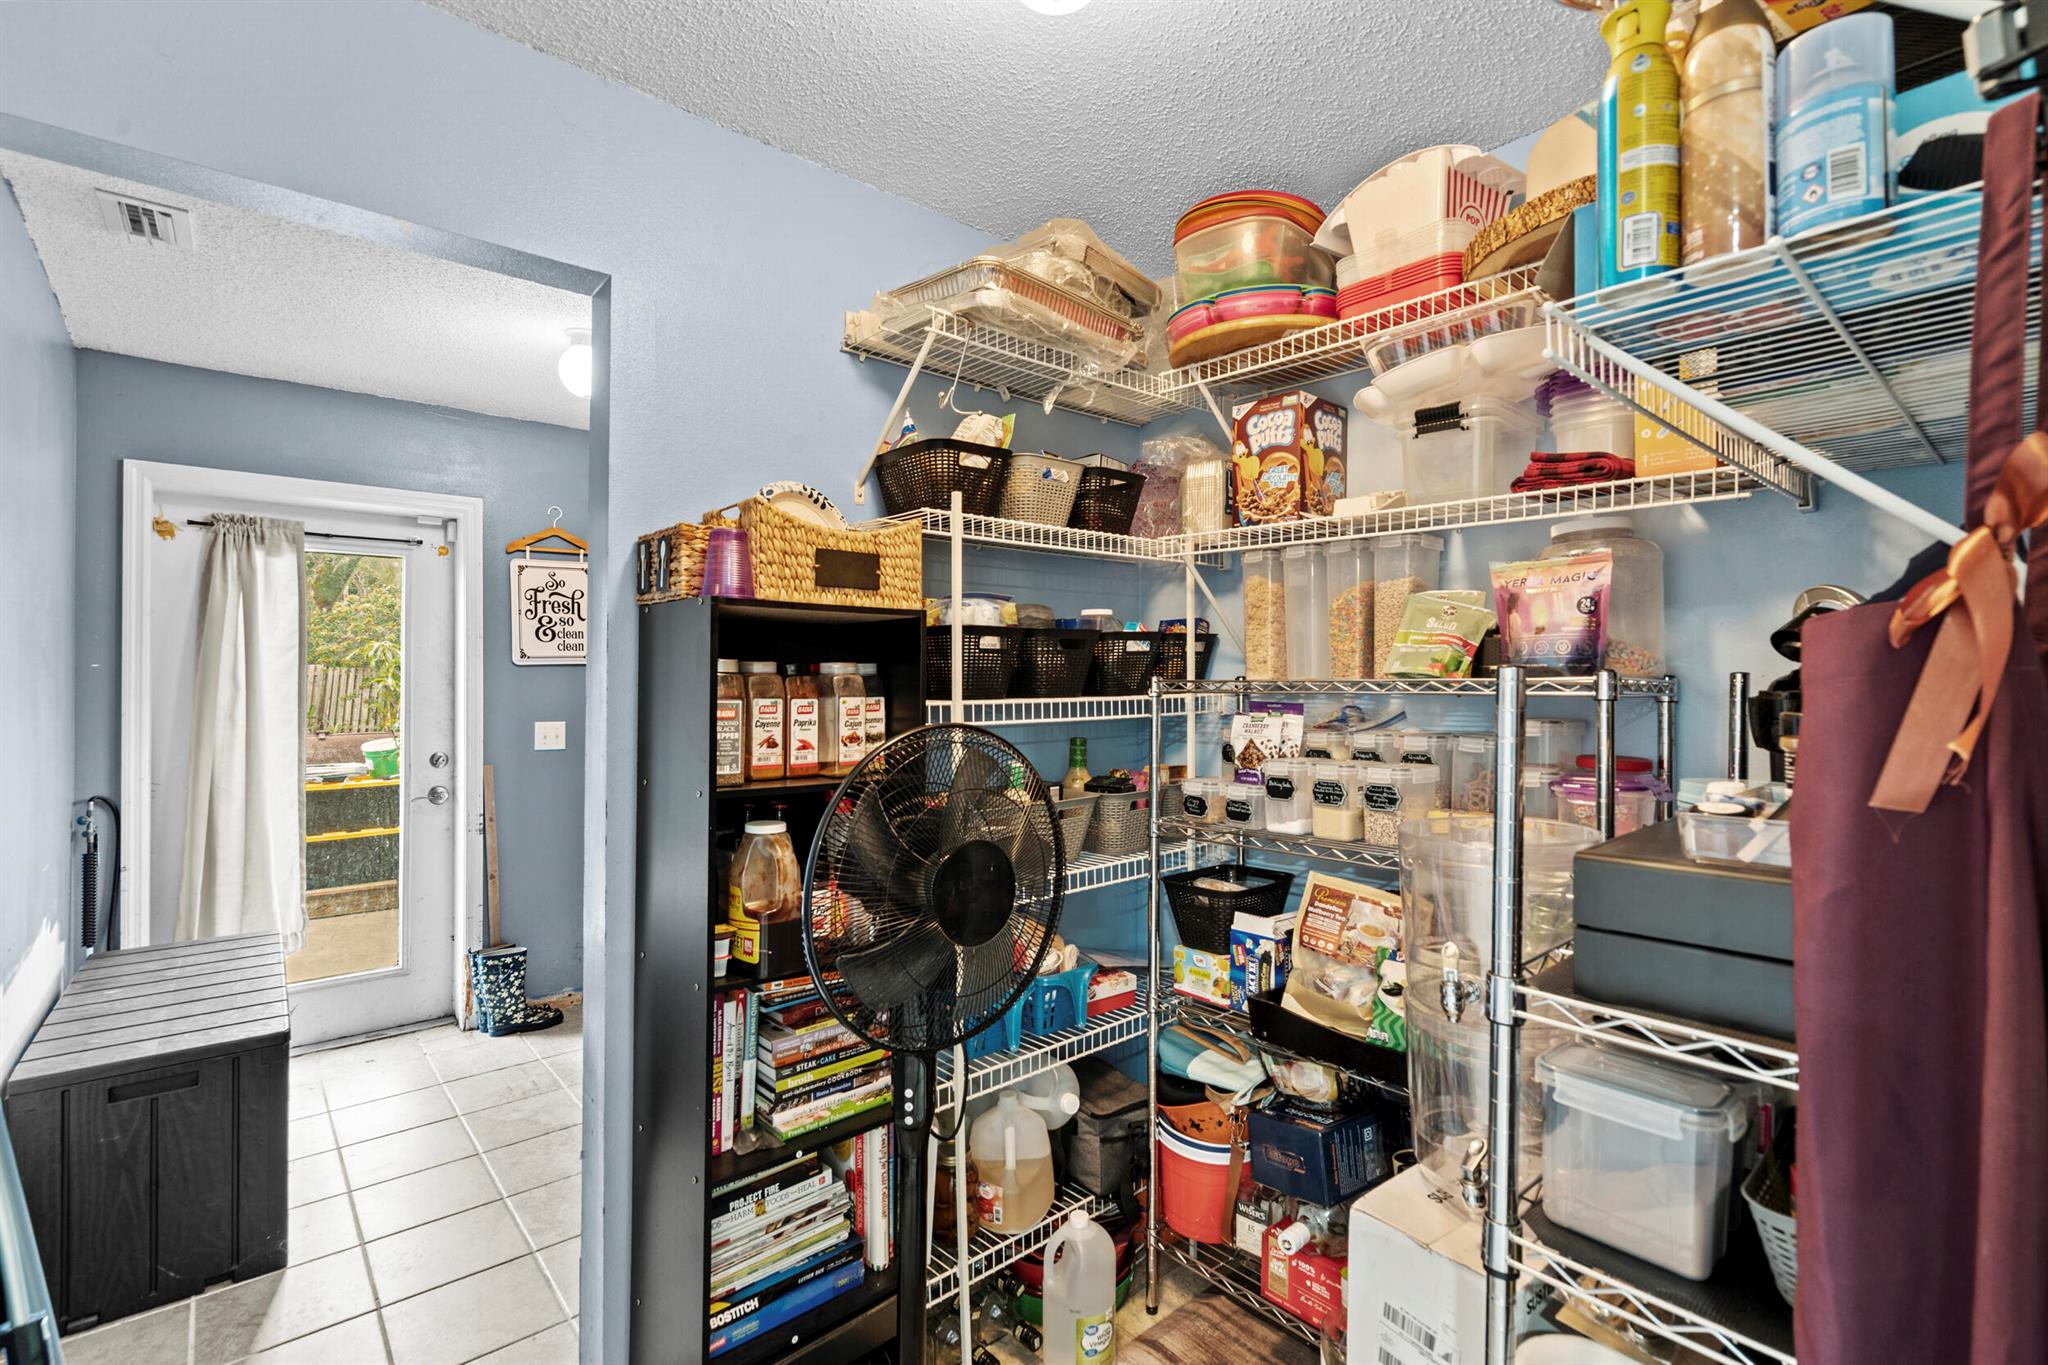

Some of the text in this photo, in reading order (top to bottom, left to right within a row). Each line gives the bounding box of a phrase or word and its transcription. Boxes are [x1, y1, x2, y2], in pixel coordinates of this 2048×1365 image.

[545, 571, 565, 591] So
[1550, 570, 1597, 585] MAGIC
[524, 586, 586, 621] Fresh
[535, 615, 574, 642] & so
[556, 628, 584, 639] clean
[557, 640, 584, 652] clean
[755, 720, 780, 729] Cayenne
[793, 719, 817, 728] Paprika
[844, 720, 862, 729] Cajun
[796, 1054, 836, 1072] STEAK CAKE
[827, 1067, 863, 1084] COOKBOOK
[729, 1182, 780, 1212] PROJECT FIRE
[730, 1207, 754, 1222] HARM
[798, 1181, 817, 1194] HEAL
[1297, 1259, 1316, 1274] 100%
[709, 1297, 759, 1330] BOSTITCH
